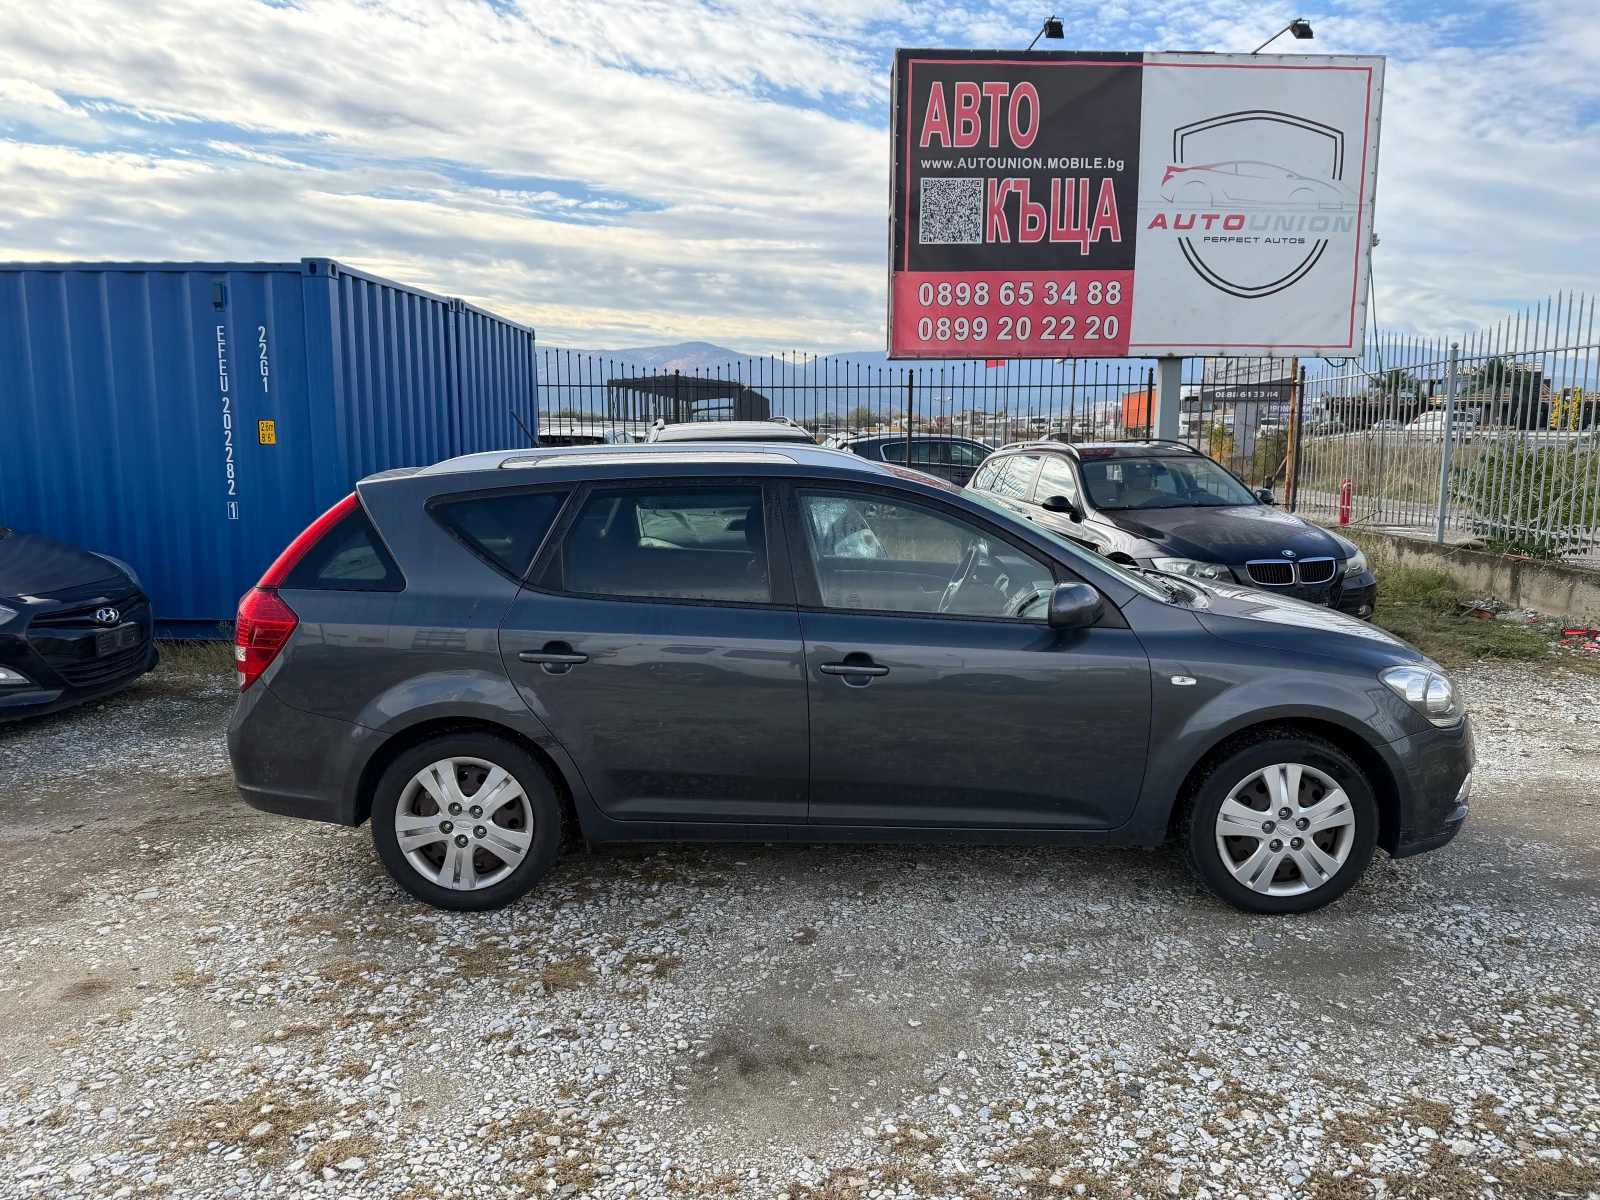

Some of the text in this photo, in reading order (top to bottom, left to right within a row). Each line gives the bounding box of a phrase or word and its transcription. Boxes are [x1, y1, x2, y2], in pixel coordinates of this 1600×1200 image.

[919, 81, 1040, 149] АВТО
[920, 157, 1125, 171] www.AUTOUNION.MOBILE.bg
[986, 177, 1122, 255] КЪЩА
[1147, 213, 1354, 233] AUTOUNION
[1203, 236, 1306, 245] PERFECT AUTOS
[918, 280, 1122, 306] 0898 65 34 88
[917, 315, 1119, 341] 0899 20 22 20
[216, 325, 229, 392] EFEU
[258, 325, 269, 393] 22G1
[222, 396, 236, 495] 202282
